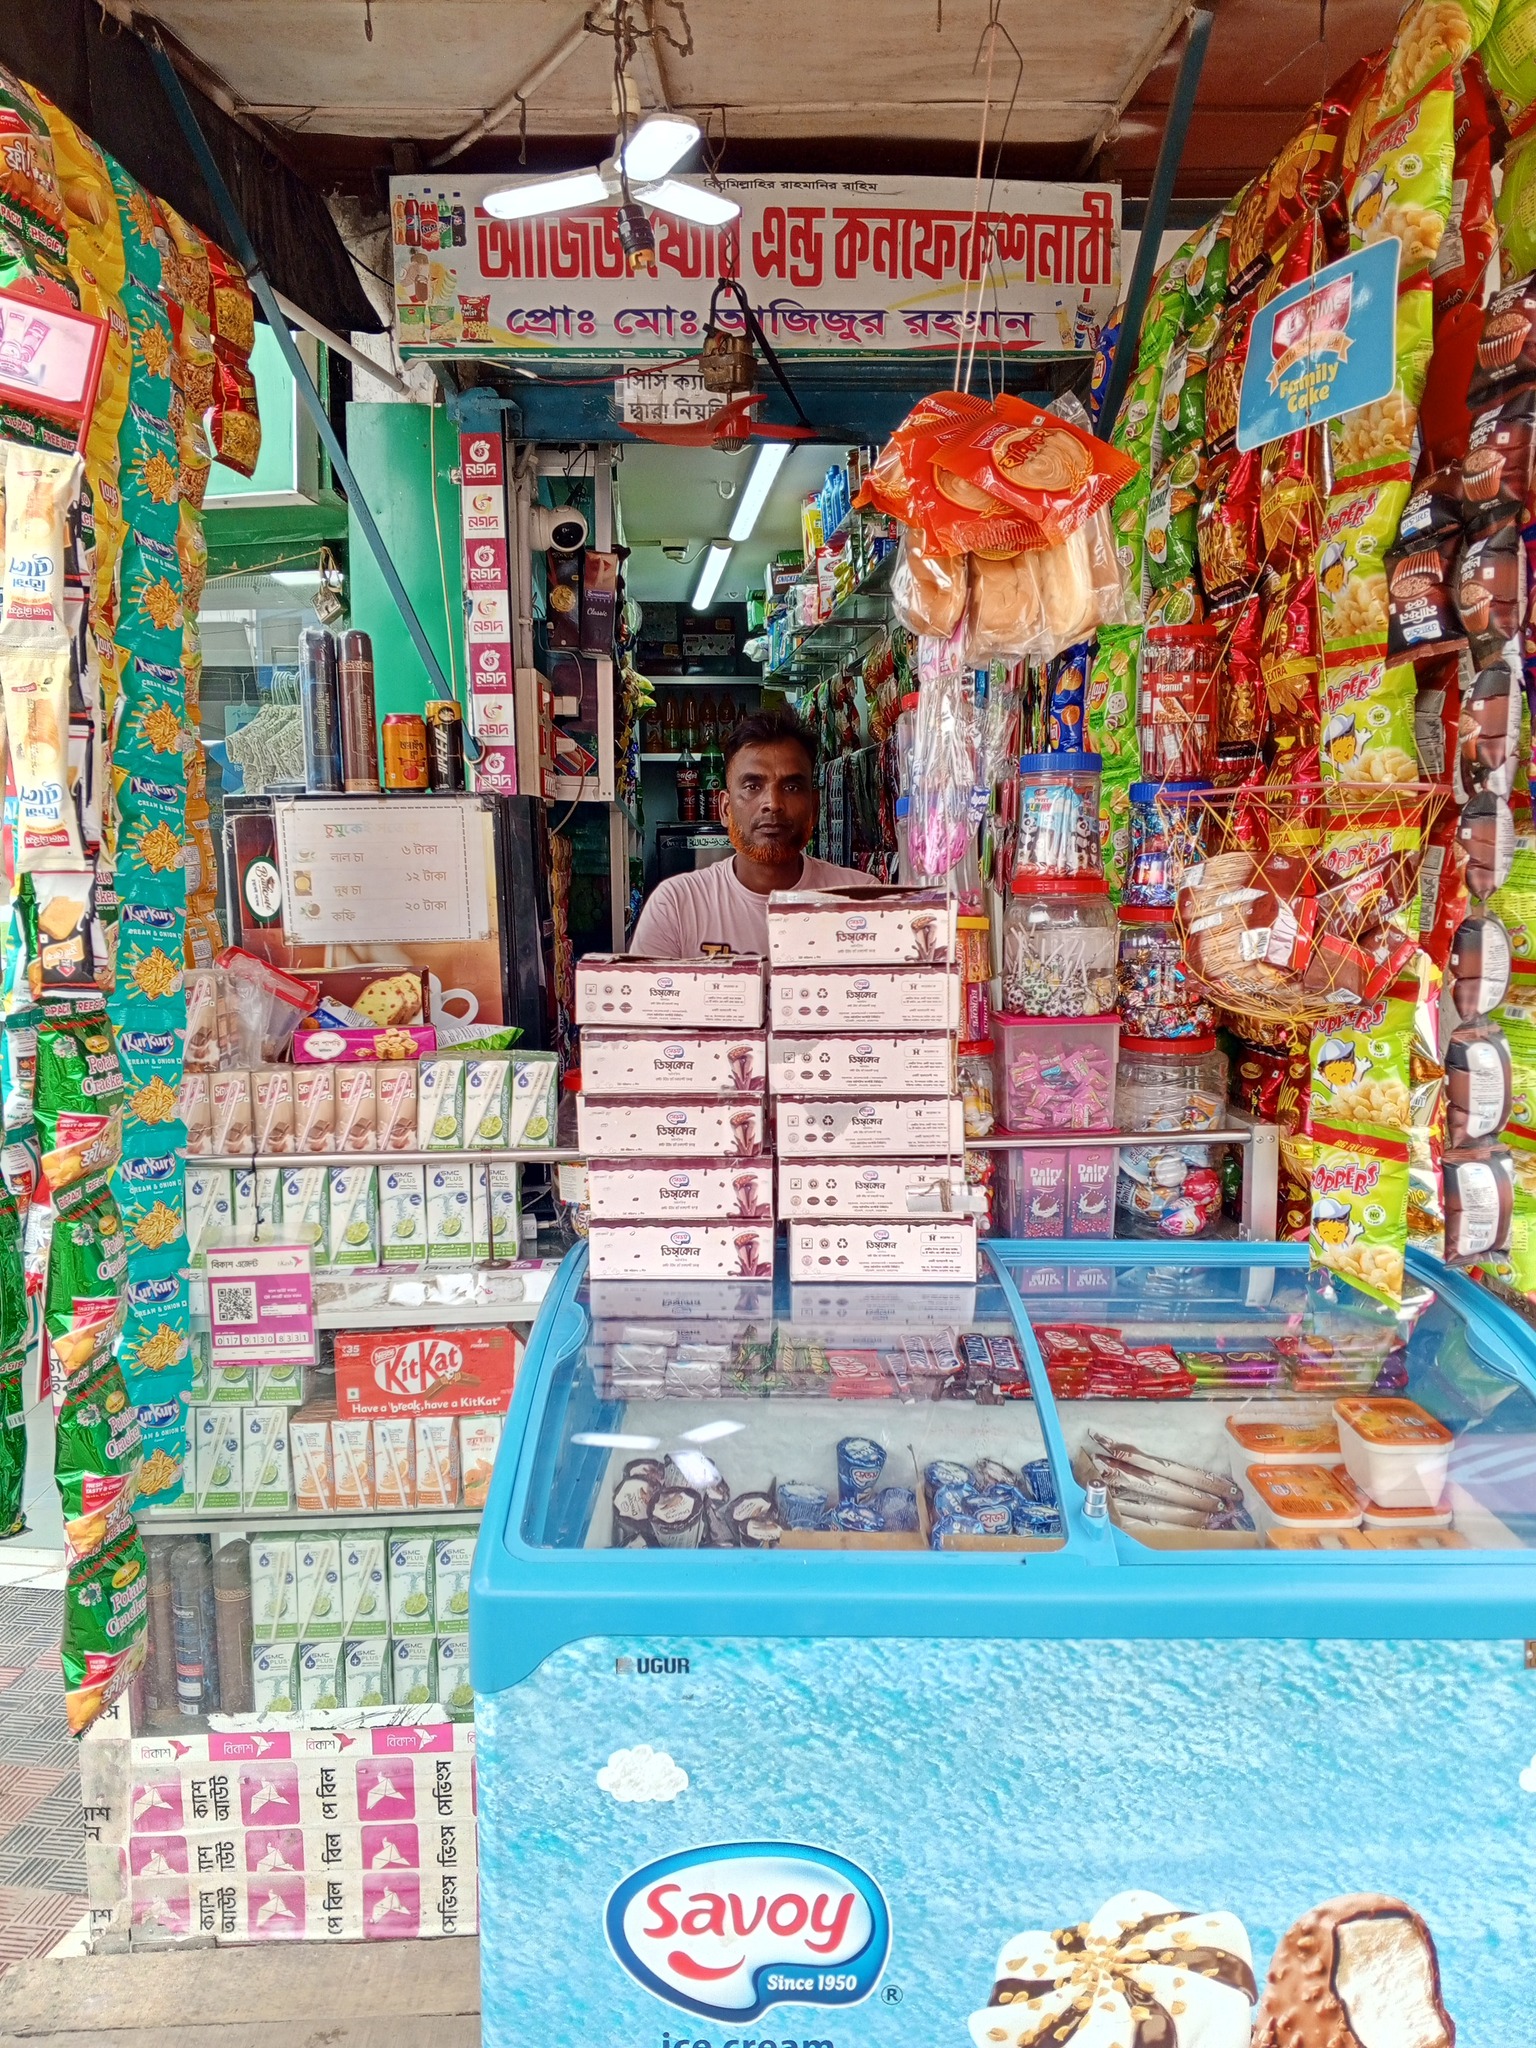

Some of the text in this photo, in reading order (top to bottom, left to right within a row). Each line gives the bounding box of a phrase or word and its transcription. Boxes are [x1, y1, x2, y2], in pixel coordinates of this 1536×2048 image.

[1404, 162, 1417, 170] NO
[841, 181, 878, 192] রাহিম
[506, 305, 597, 338] প্রোঃ
[613, 305, 698, 337] মোঃ
[1279, 361, 1339, 399] Family
[1287, 385, 1330, 413] Cake
[43, 431, 61, 448] FREE
[465, 463, 497, 475] নগদ
[468, 516, 499, 527] নগদ
[470, 568, 502, 580] নগদ
[587, 607, 608, 617] Classic
[473, 621, 504, 632] নগদ
[136, 656, 179, 685] Kurkure
[475, 672, 507, 685] নগদ
[1267, 665, 1288, 684] EXTRA
[142, 679, 160, 689] CREAM
[1156, 683, 1184, 692] Peanut
[479, 724, 509, 735] নগদ
[131, 776, 179, 804] Kurkure
[138, 800, 180, 814] CREAM ONION
[330, 843, 438, 863] লাল চা ৬ টাকা
[333, 869, 447, 897] দুধ চা ১২ টাকা
[122, 903, 176, 929] Kurkure
[331, 898, 447, 922] কফি ২০ টাকা
[970, 988, 979, 1028] EUROPE
[121, 1032, 175, 1057] Kurkure
[87, 1053, 119, 1075] Potato
[128, 1058, 150, 1066] CREAM
[122, 1151, 176, 1182] Kurkure
[1030, 1167, 1062, 1179] Dairy
[1078, 1164, 1110, 1176] Dairy
[160, 1180, 177, 1190] ONION
[1032, 1176, 1058, 1187] Milk
[1080, 1172, 1105, 1183] Milk
[1369, 1211, 1382, 1219] NO
[211, 1259, 259, 1270] বিকাশ এজেন্ট
[279, 1334, 308, 1342] 8331
[385, 1341, 460, 1394] KitKat
[352, 1403, 379, 1414] Have
[424, 1400, 449, 1411] have
[637, 1658, 690, 1674] UGUR
[223, 1741, 254, 1756] বিকাশ
[305, 1738, 336, 1752] বিকাশ
[386, 1734, 416, 1748] বিকাশ
[141, 1745, 171, 1760] বিকাশ
[316, 1767, 338, 1820] পে বিল
[432, 1760, 452, 1816] সেভিংস
[191, 1780, 209, 1819] ক্যাশ
[214, 1775, 229, 1821] আউট
[200, 1891, 216, 1931] ক্যাশ
[221, 1886, 236, 1934] আউট
[324, 1880, 342, 1935] পে বিল
[437, 1874, 458, 1935] সেভিংস
[643, 1884, 855, 1953] Savoy
[767, 1974, 857, 1992] Since 1950
